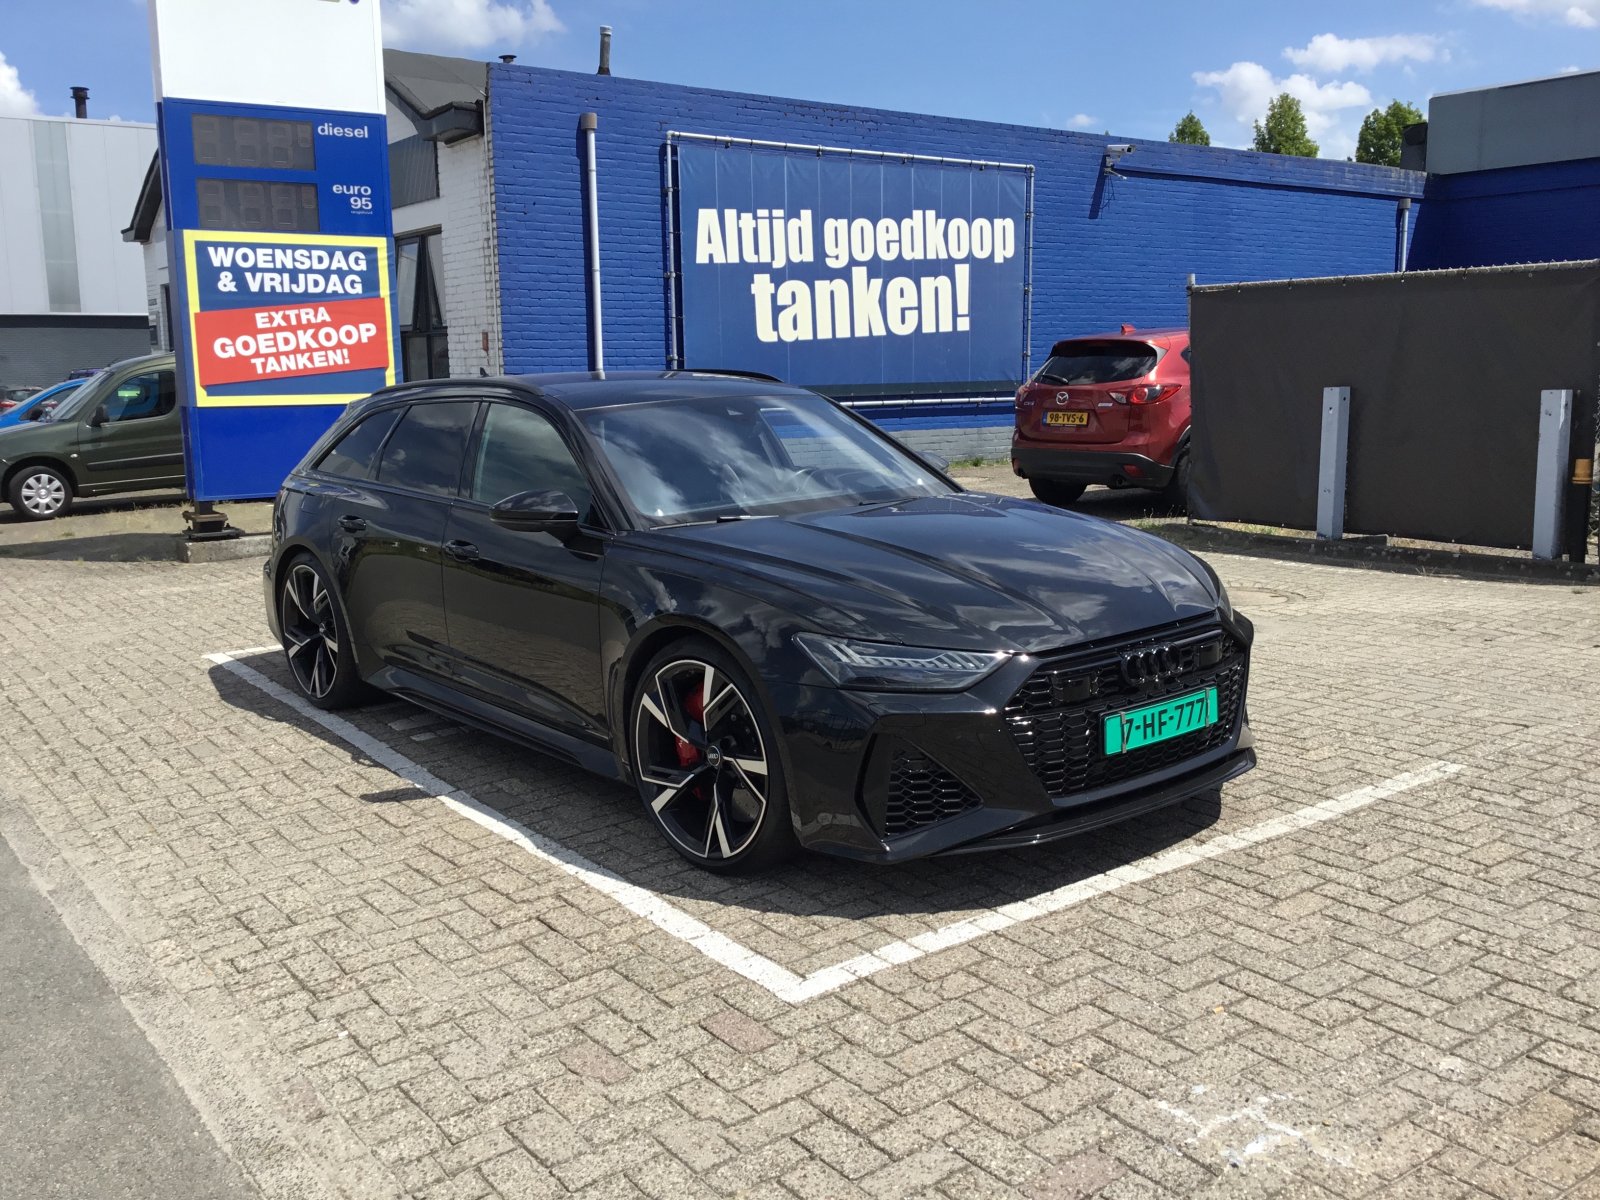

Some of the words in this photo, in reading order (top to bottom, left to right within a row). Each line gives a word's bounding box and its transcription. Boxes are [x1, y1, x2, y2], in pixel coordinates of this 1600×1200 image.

[317, 123, 369, 138] diesel
[332, 184, 372, 196] euro
[350, 196, 373, 210] 95
[695, 208, 814, 269] Altijd
[823, 209, 1015, 269] goedkoop
[207, 246, 367, 271] WOENSDAG
[217, 271, 238, 292] &
[245, 272, 363, 294] VRIJDAG
[751, 263, 970, 342] tanken!
[255, 307, 331, 329] EXTRA
[213, 323, 377, 359] GOEDKOOP
[250, 349, 350, 374] TANKEN!
[1049, 413, 1085, 423] 98-TVS-6
